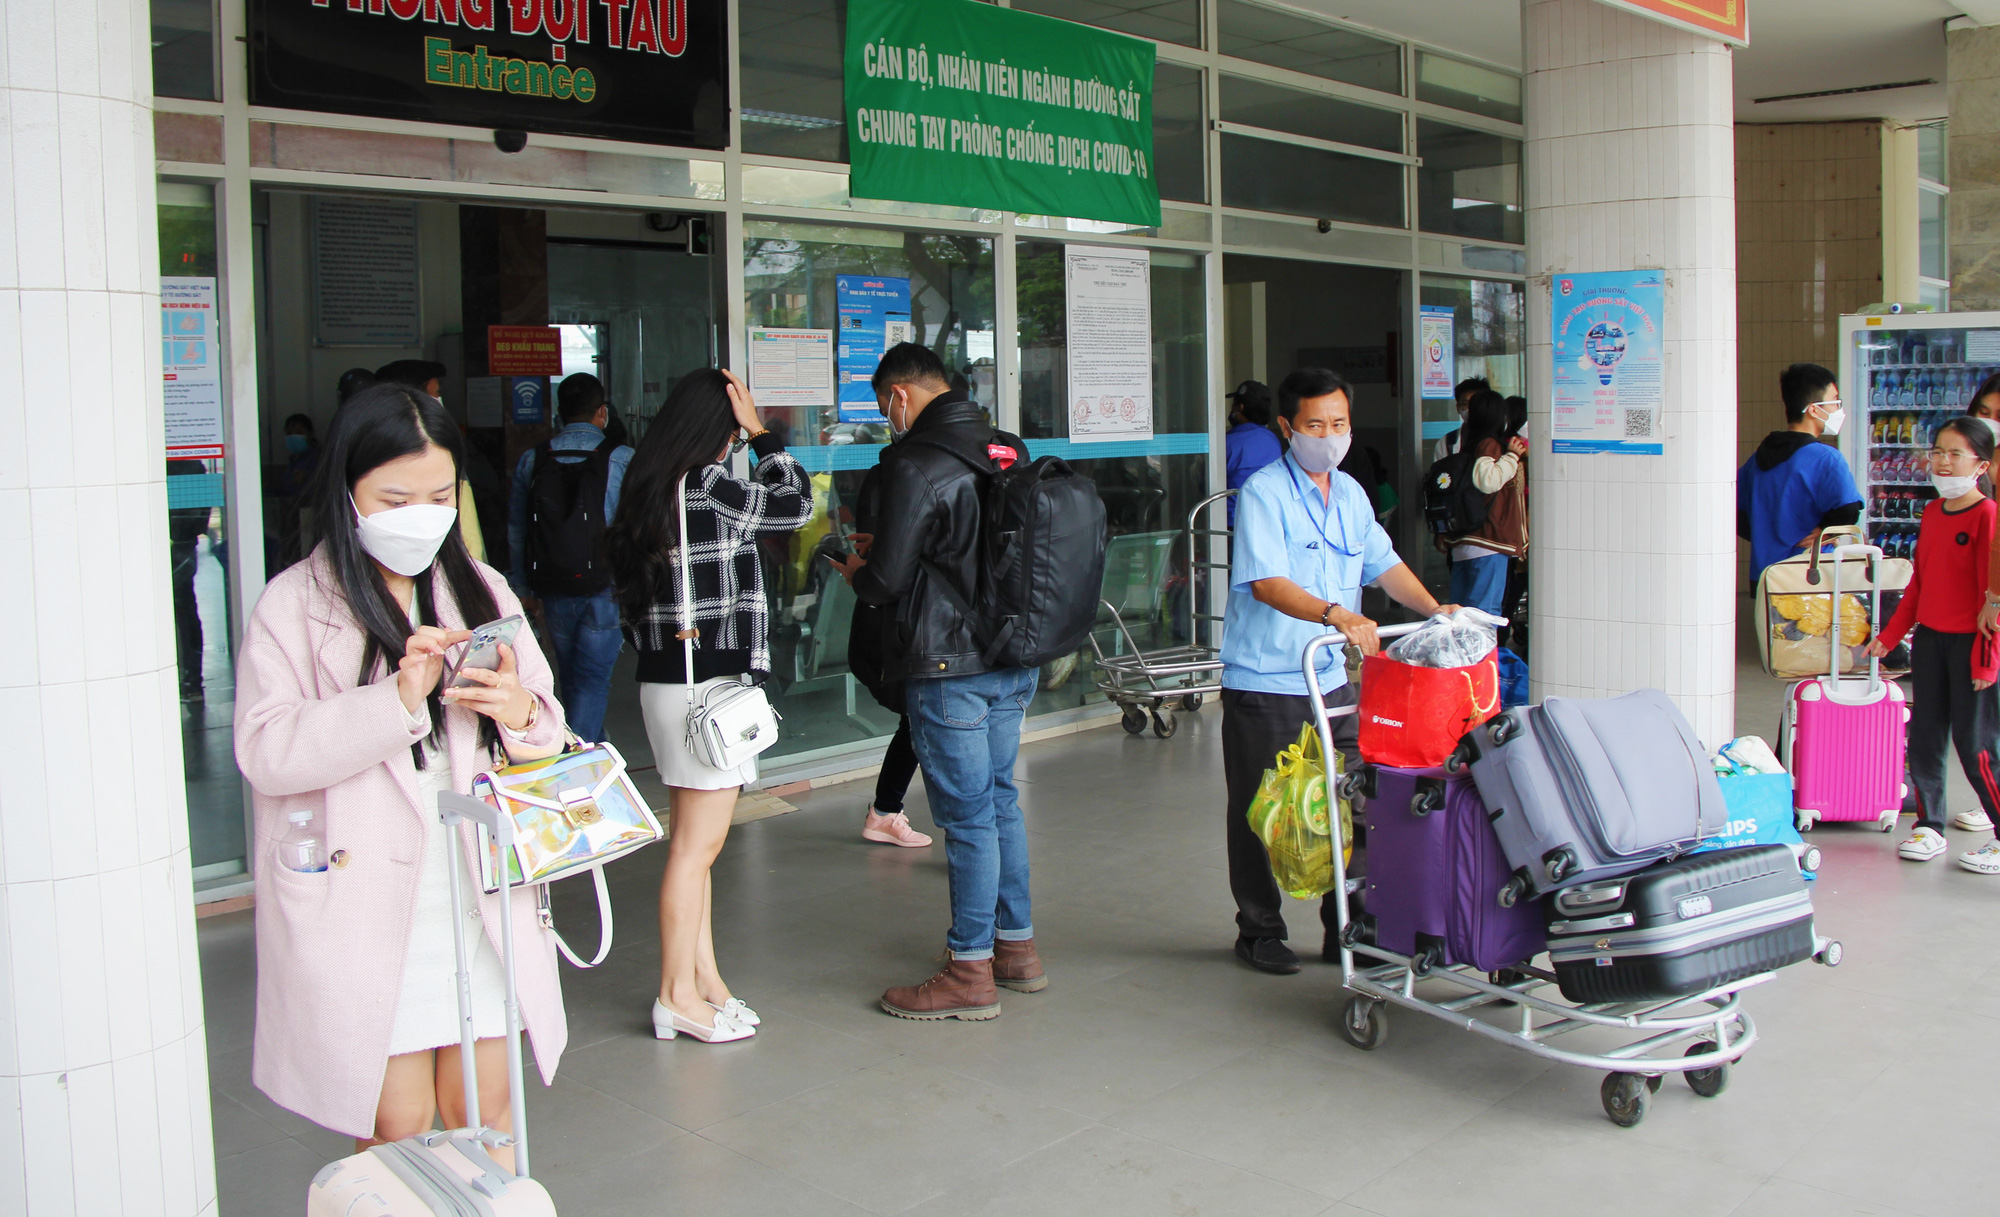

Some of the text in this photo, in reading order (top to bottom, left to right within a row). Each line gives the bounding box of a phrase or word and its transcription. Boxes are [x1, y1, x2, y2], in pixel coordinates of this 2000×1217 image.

[424, 36, 596, 102] Entrance
[864, 38, 1141, 122] CÁN BỘ, NHÂN VIÊN NGÀNH ĐƯỜNG SẮT
[857, 107, 1148, 180] CHUNG TAY PHÒNG CHỐNG DỊCH COVID-19
[1379, 717, 1403, 728] ORION
[1979, 863, 2000, 871] cro
